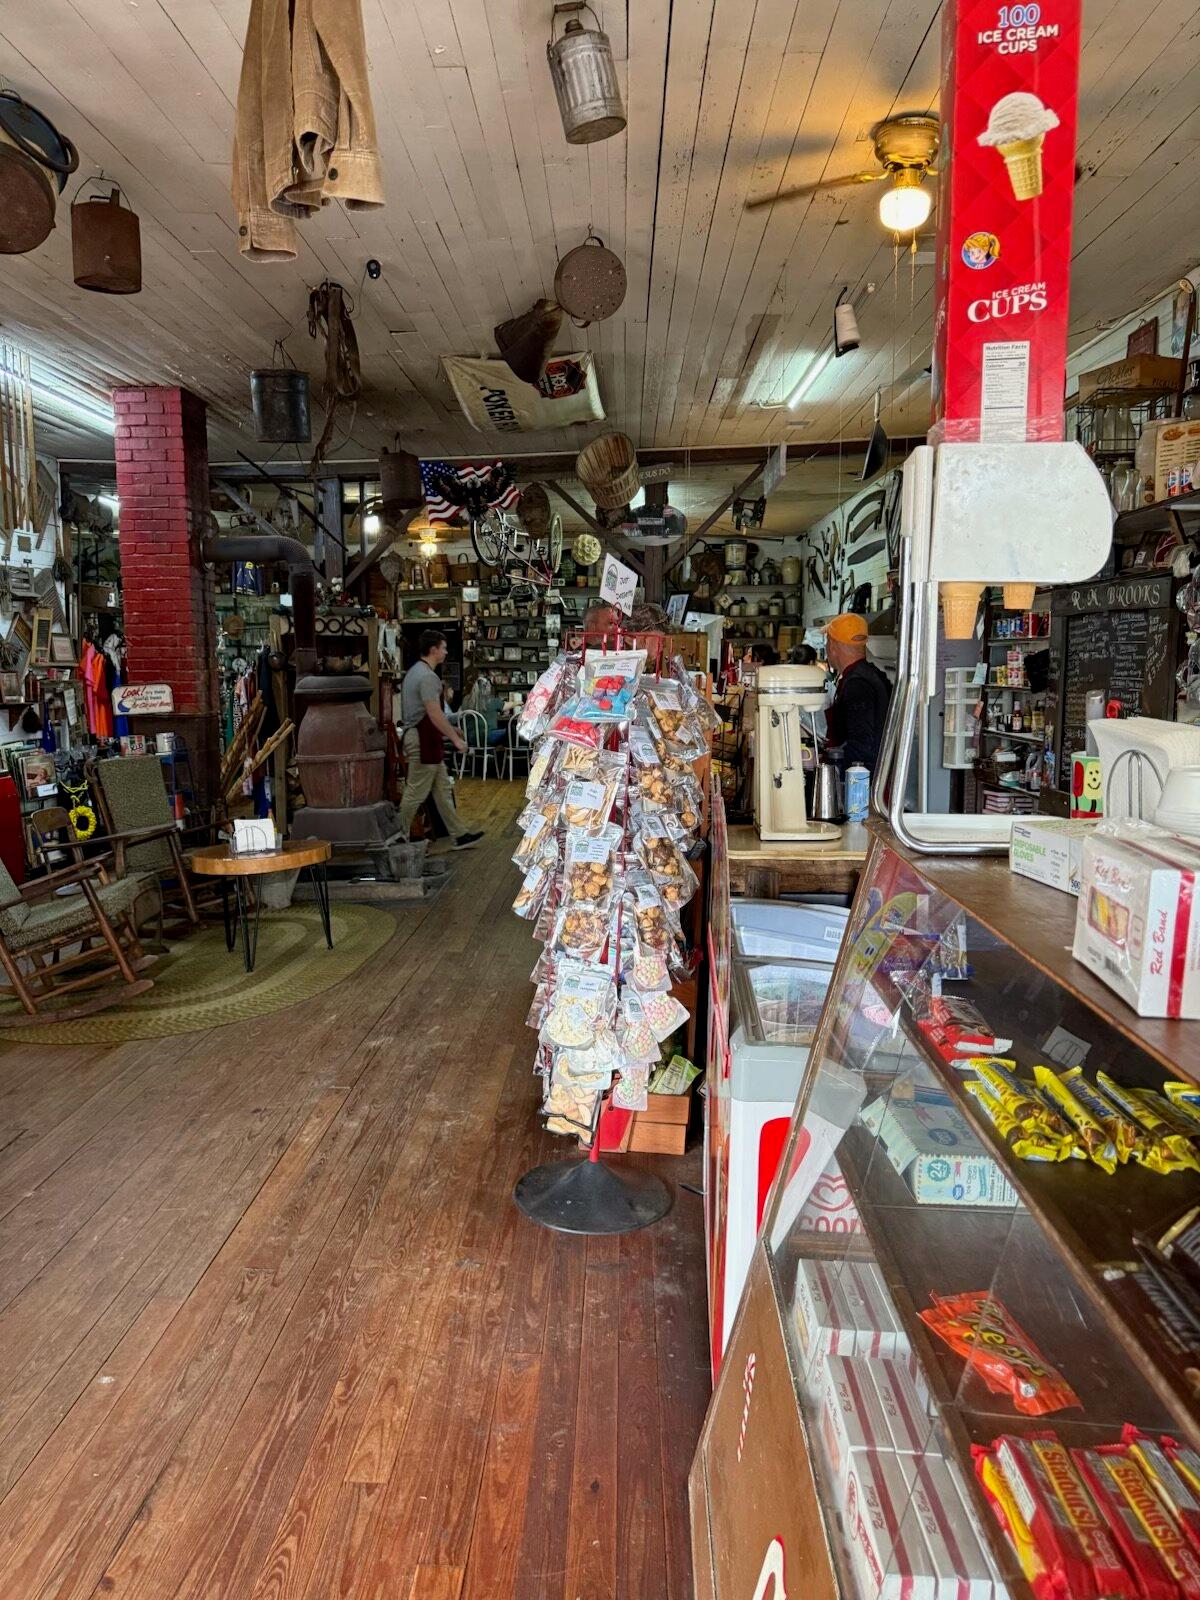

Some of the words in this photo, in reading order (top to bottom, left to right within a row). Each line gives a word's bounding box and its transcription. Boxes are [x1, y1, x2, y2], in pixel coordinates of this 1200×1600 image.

[998, 3, 1041, 28] 100
[978, 30, 1003, 45] ICE
[1006, 24, 1060, 42] CREAM
[998, 39, 1038, 54] CUPS
[992, 289, 1009, 300] ICE
[1011, 281, 1046, 297] CREAM
[967, 290, 1048, 323] CUPS
[640, 469, 658, 480] ESUS
[1107, 584, 1160, 607] BROOKS
[121, 685, 147, 699] Look!
[1153, 909, 1168, 943] Band
[1150, 948, 1163, 975] Red
[930, 1162, 942, 1178] 24
[866, 1484, 880, 1508] Band
[1041, 1450, 1101, 1528] Starburst
[917, 1489, 931, 1513] Band
[1114, 1466, 1185, 1546] Starburst
[872, 1511, 886, 1531] Red
[925, 1515, 938, 1536] Red
